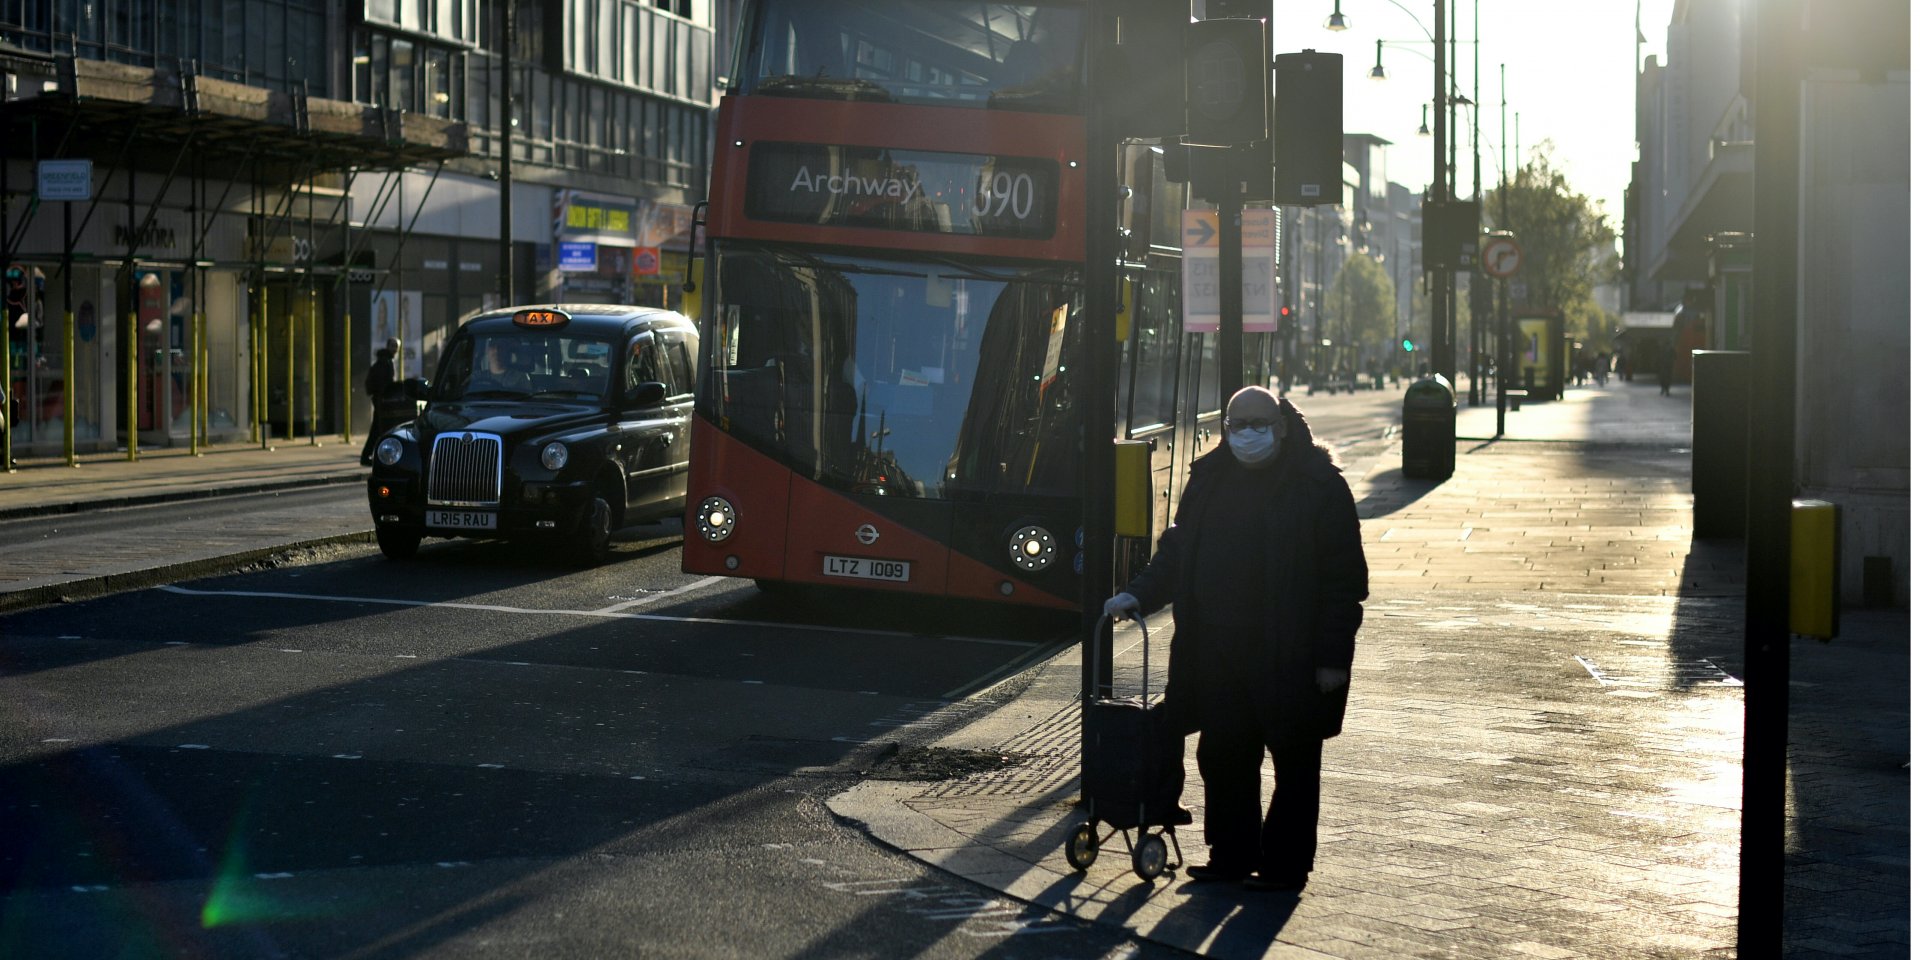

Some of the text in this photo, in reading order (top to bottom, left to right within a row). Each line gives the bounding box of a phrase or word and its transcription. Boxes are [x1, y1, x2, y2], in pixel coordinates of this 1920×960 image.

[790, 165, 922, 204] Archway
[115, 224, 176, 248] PADORA
[523, 312, 555, 324] TAXI
[432, 511, 489, 526] LR15 RAU
[829, 558, 904, 578] LTZ 1009
